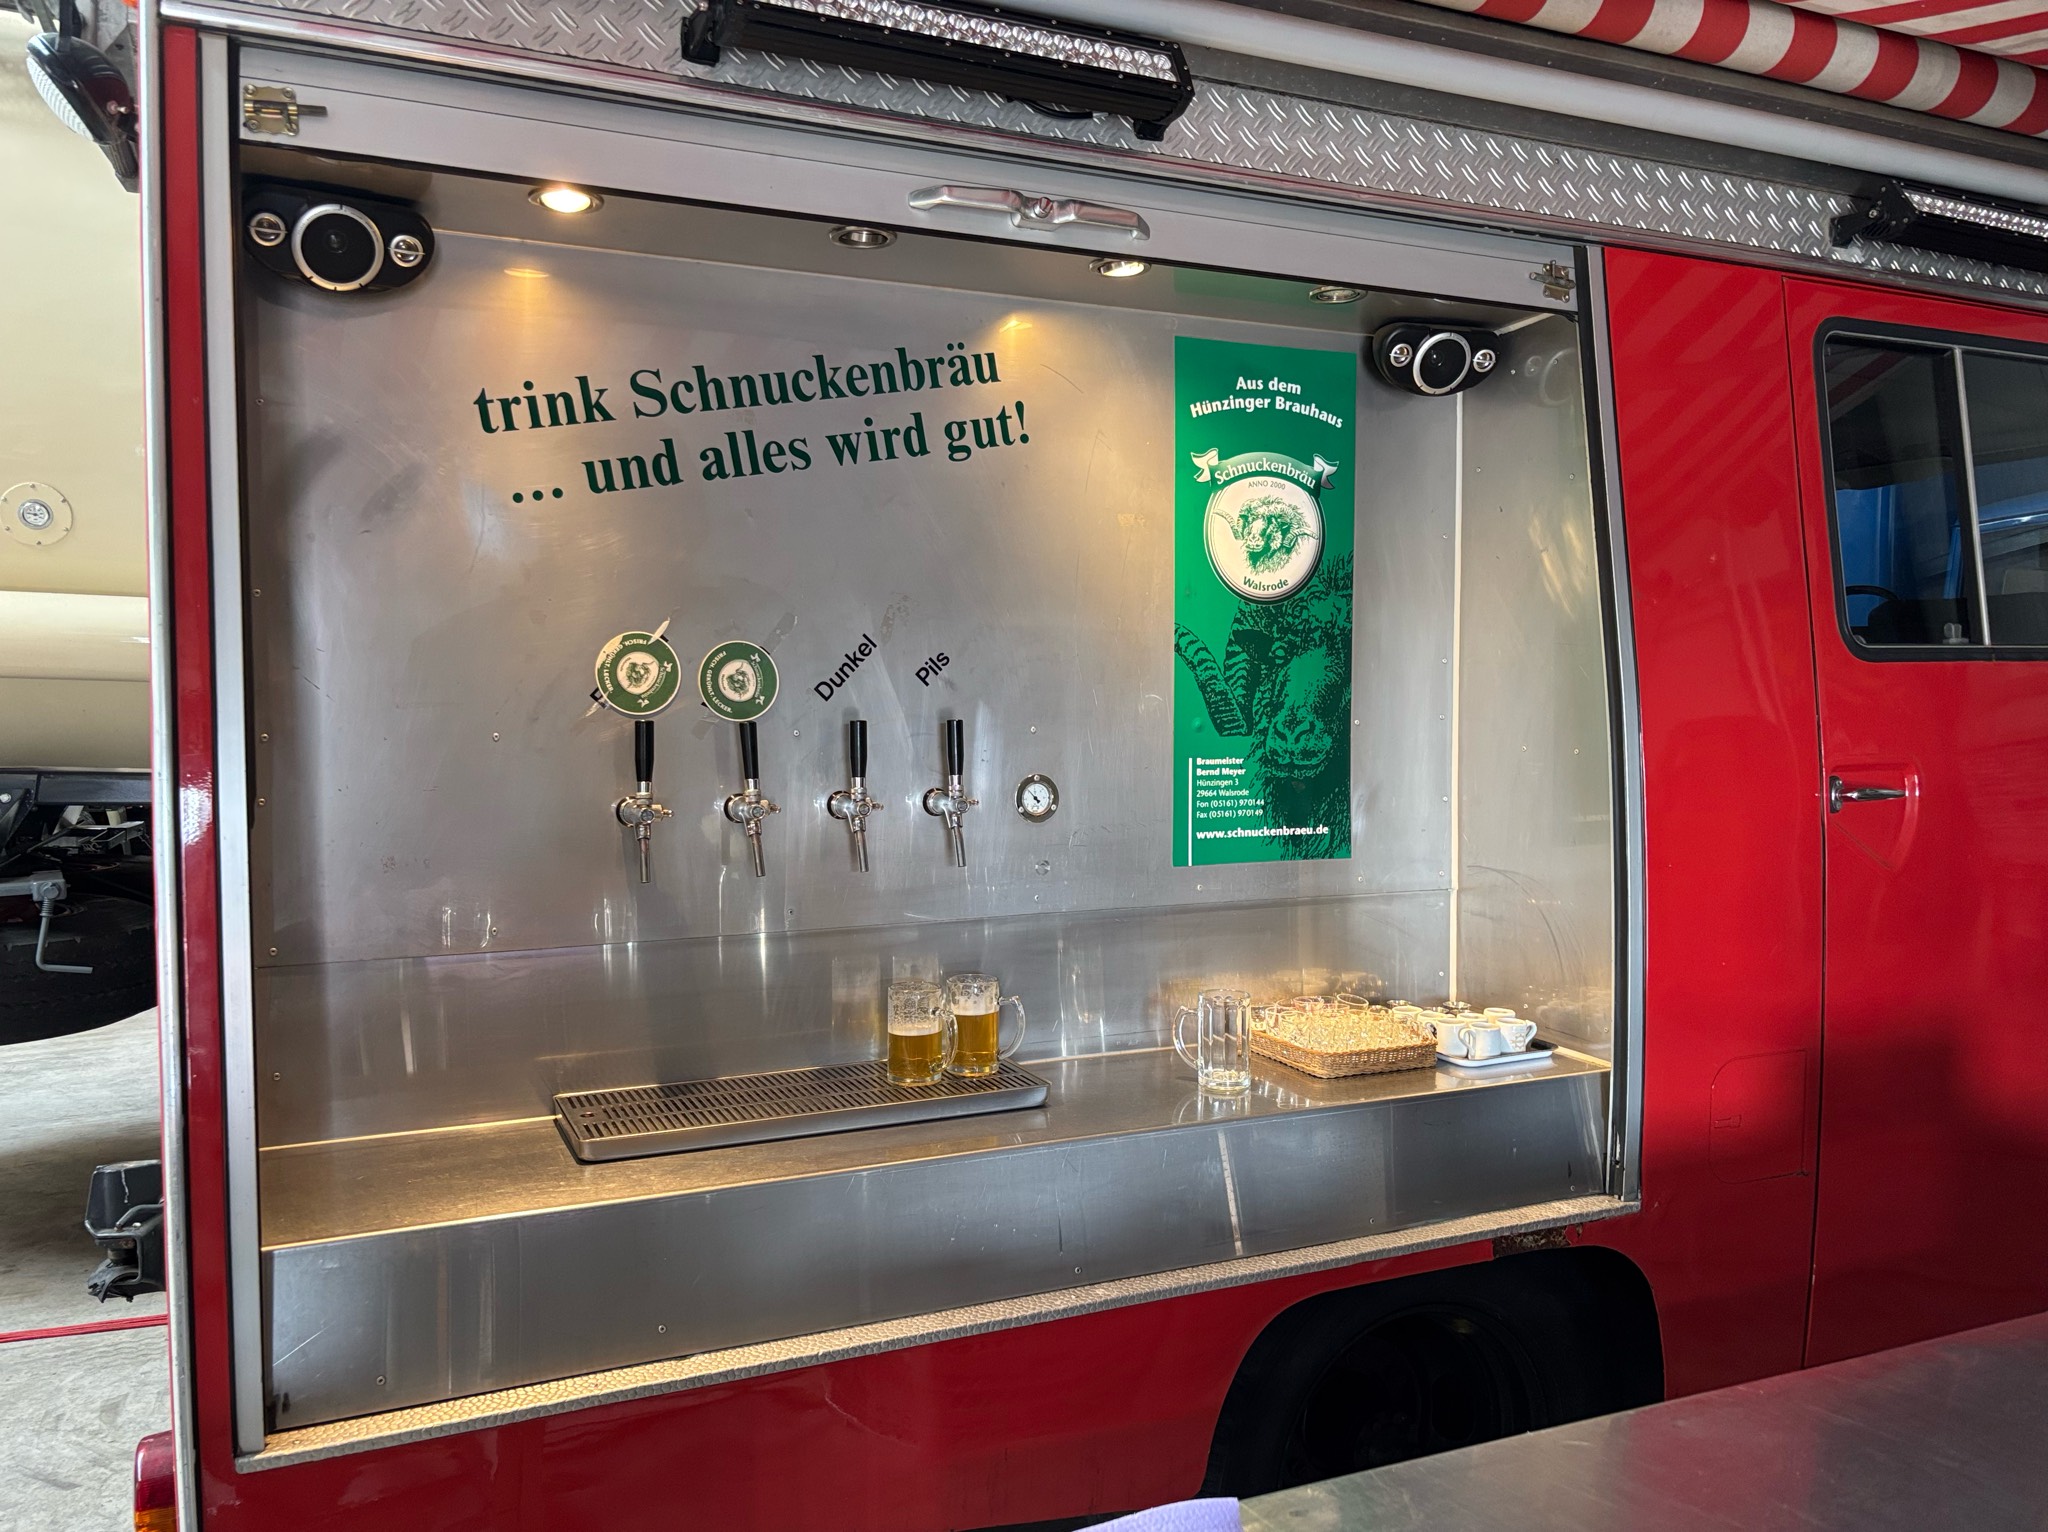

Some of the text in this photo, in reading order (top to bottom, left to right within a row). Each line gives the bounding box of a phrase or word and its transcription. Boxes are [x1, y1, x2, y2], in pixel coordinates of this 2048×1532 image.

[473, 342, 1001, 434] trink Schnuckenbräu
[1236, 376, 1301, 395] Aus dem
[1189, 395, 1343, 429] Hünzinger Brauhaus
[581, 438, 684, 494] und
[699, 430, 812, 481] alles
[825, 412, 931, 466] wird
[944, 400, 1030, 462] gut!
[1214, 457, 1316, 489] Schnuckenbräu
[1248, 480, 1286, 490] ANNO 2000
[1243, 576, 1289, 592] Walsrode
[814, 633, 878, 702] Dunkel
[915, 651, 950, 687] Pils
[1196, 757, 1245, 765] Braumeister
[1196, 768, 1246, 777] Bernd Meyer
[1196, 778, 1239, 788] Hünzingen 3
[1218, 789, 1249, 797] Walsrode
[1196, 811, 1208, 819] Fax
[1196, 824, 1329, 839] www.schnuckenbraeu.de
